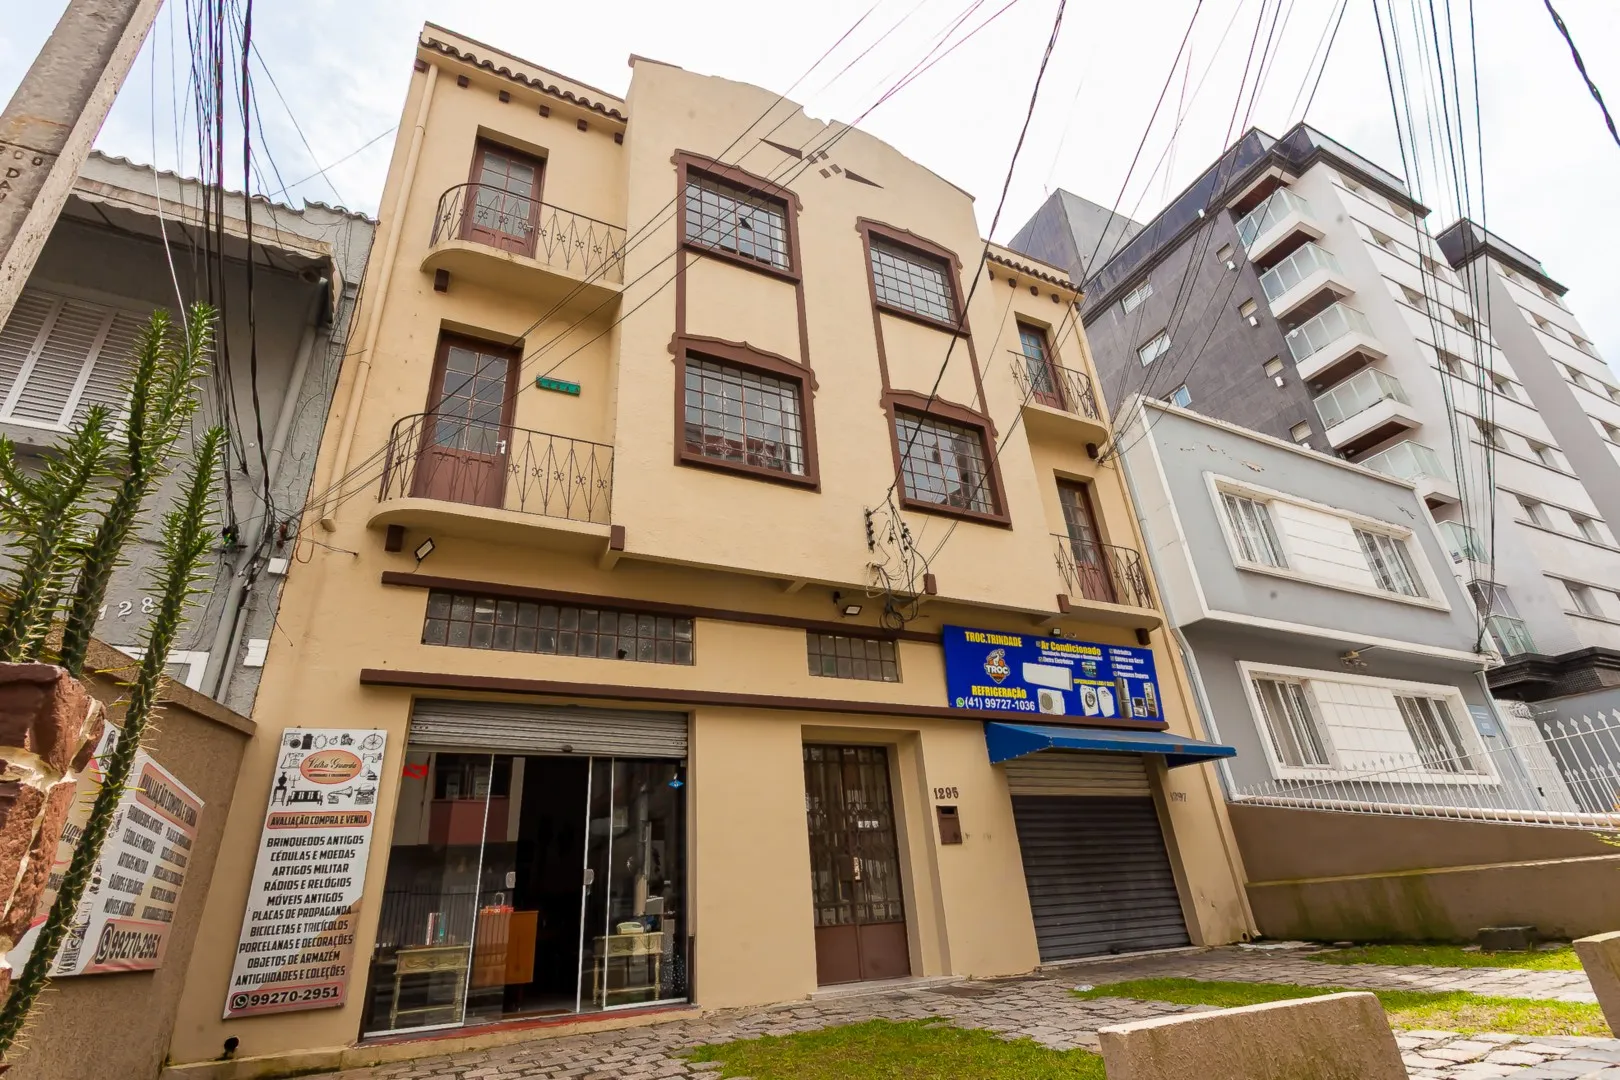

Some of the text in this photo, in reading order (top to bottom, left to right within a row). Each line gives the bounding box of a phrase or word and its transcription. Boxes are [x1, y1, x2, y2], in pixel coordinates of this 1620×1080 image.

[964, 631, 1023, 647] TROC.TRINDADE
[1041, 640, 1050, 650] Ar
[1050, 641, 1103, 656] Condicionado
[985, 665, 1009, 674] TROC
[971, 685, 1028, 699] REFRIGERAÇÃO
[964, 697, 1036, 711] (41) 99727-1036
[933, 786, 959, 800] 1295
[270, 814, 368, 828] AVALIAÇÃO COMPRA E VENDA
[266, 835, 364, 848] BRINQUEDOS ANTIGOS
[270, 849, 356, 862] CÉDULAS E MOEDAS
[271, 863, 349, 876] ARTIGOS MILITAR
[263, 877, 352, 892] RÁDIOS E RELÓGIOS
[266, 892, 344, 906] MÓVEIS ANTIGOS
[252, 905, 352, 921] PLACAS DE PROPAGANDA
[250, 924, 295, 937] BICICLETAS
[296, 923, 302, 933] E
[109, 929, 162, 960] 99270-2951
[239, 934, 354, 954] PORCELANAS E DECORAÇÕES
[247, 951, 340, 969] OBJETOS DE ARMAZÉM
[235, 965, 346, 986] ANTIGUIDADES E COLEÇÕES
[250, 986, 340, 1006] 99270-2951
